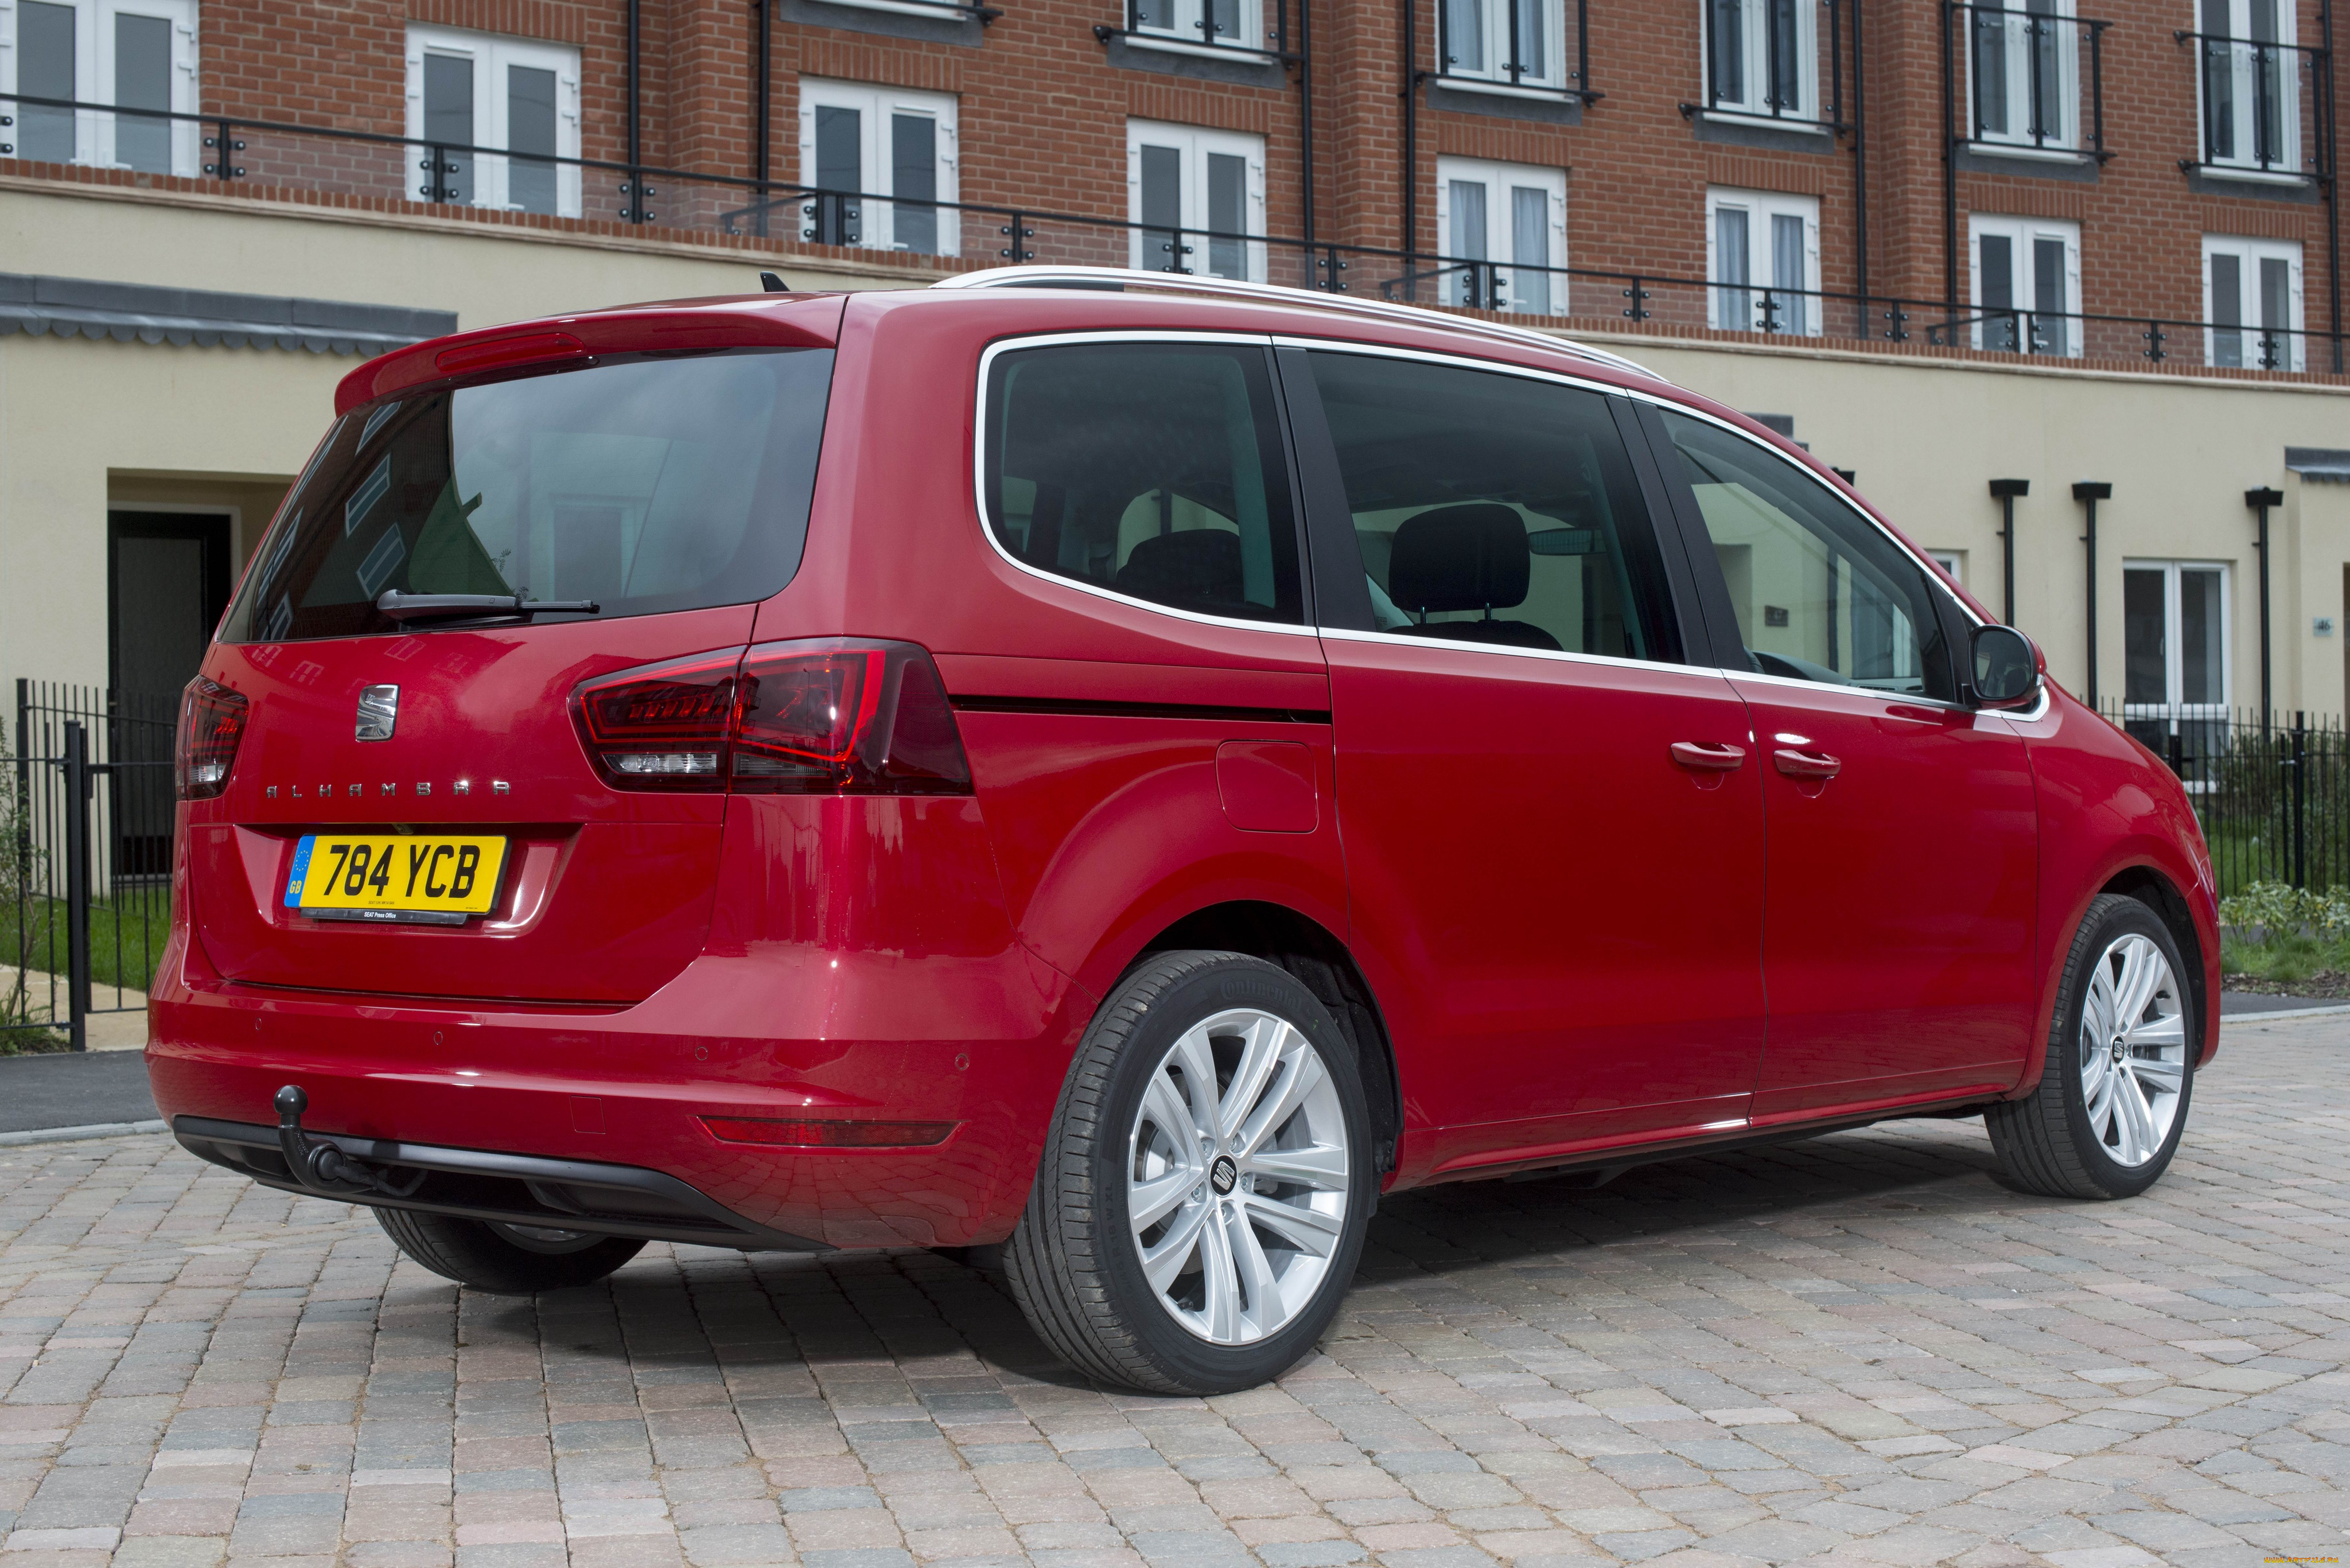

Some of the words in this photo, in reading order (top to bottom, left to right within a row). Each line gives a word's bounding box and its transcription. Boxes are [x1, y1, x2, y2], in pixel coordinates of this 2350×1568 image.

[266, 781, 510, 798] ALHAMBRA
[324, 845, 394, 897] 784
[405, 845, 480, 898] YCB
[289, 880, 301, 894] GB
[1220, 976, 1302, 1013] Continental
